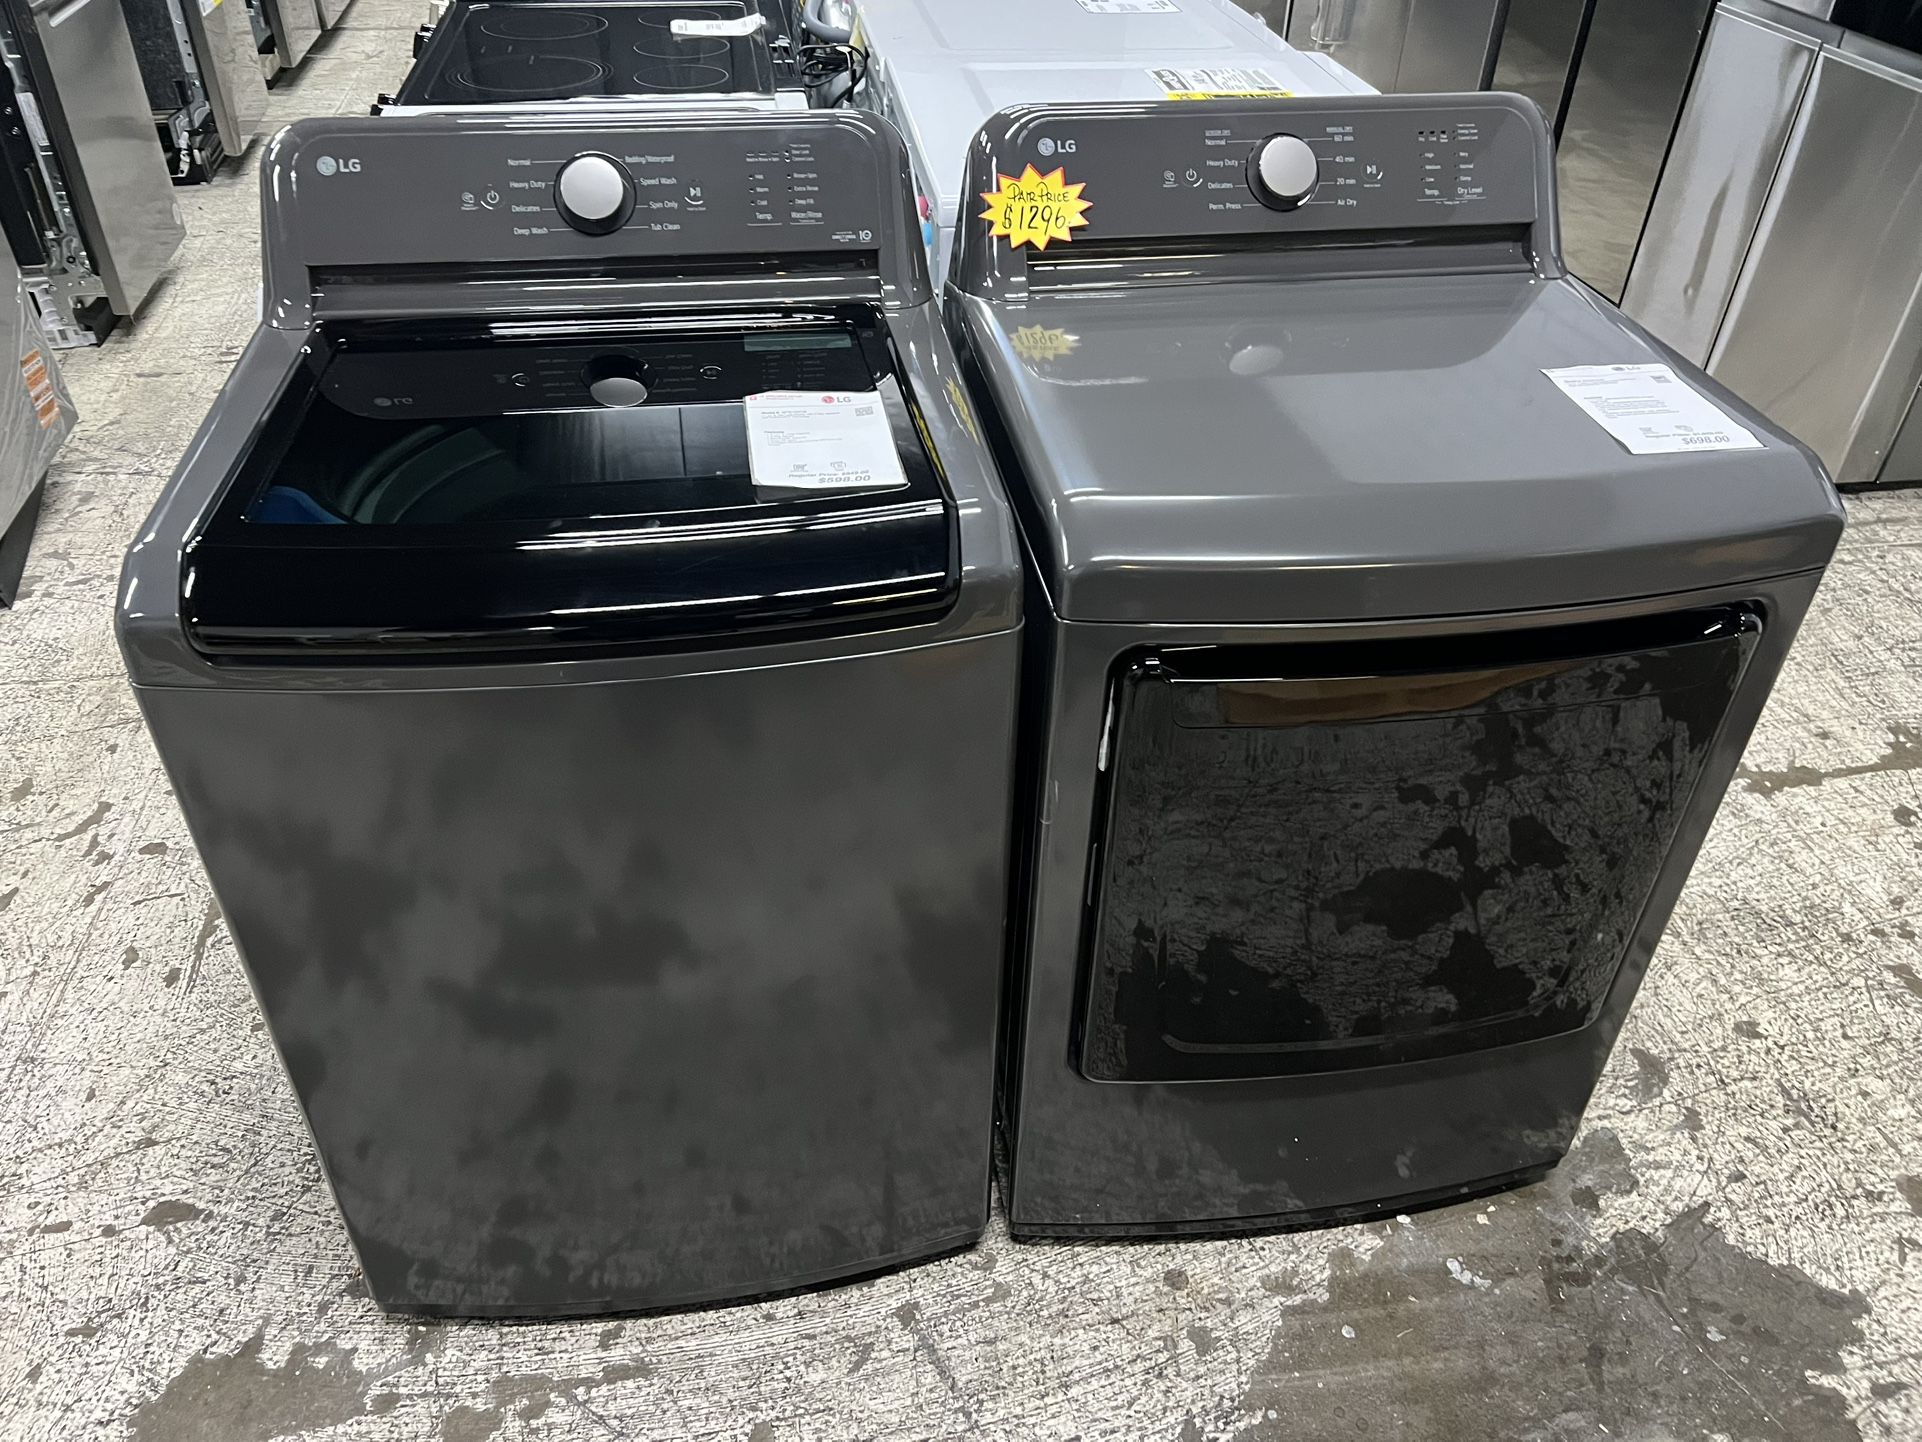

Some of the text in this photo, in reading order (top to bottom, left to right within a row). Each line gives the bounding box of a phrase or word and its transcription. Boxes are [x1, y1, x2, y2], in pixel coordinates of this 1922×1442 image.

[1057, 140, 1076, 153] LG
[339, 159, 361, 172] LG
[507, 158, 531, 166] Normal
[1206, 159, 1239, 168] Heavy Duty
[509, 180, 546, 189] Heavy Duty
[640, 177, 659, 186] Speed
[1037, 182, 1070, 203] PRICE
[1457, 187, 1468, 195] Dry
[649, 201, 663, 209] Spin
[664, 200, 678, 209] Only
[1226, 202, 1242, 210] Press
[1346, 199, 1357, 207] Dry
[1002, 204, 1067, 235] $1296
[650, 223, 662, 231] Tub
[513, 228, 530, 236] Deep
[1681, 434, 1730, 445] $698.00
[818, 474, 871, 484] $598.00
